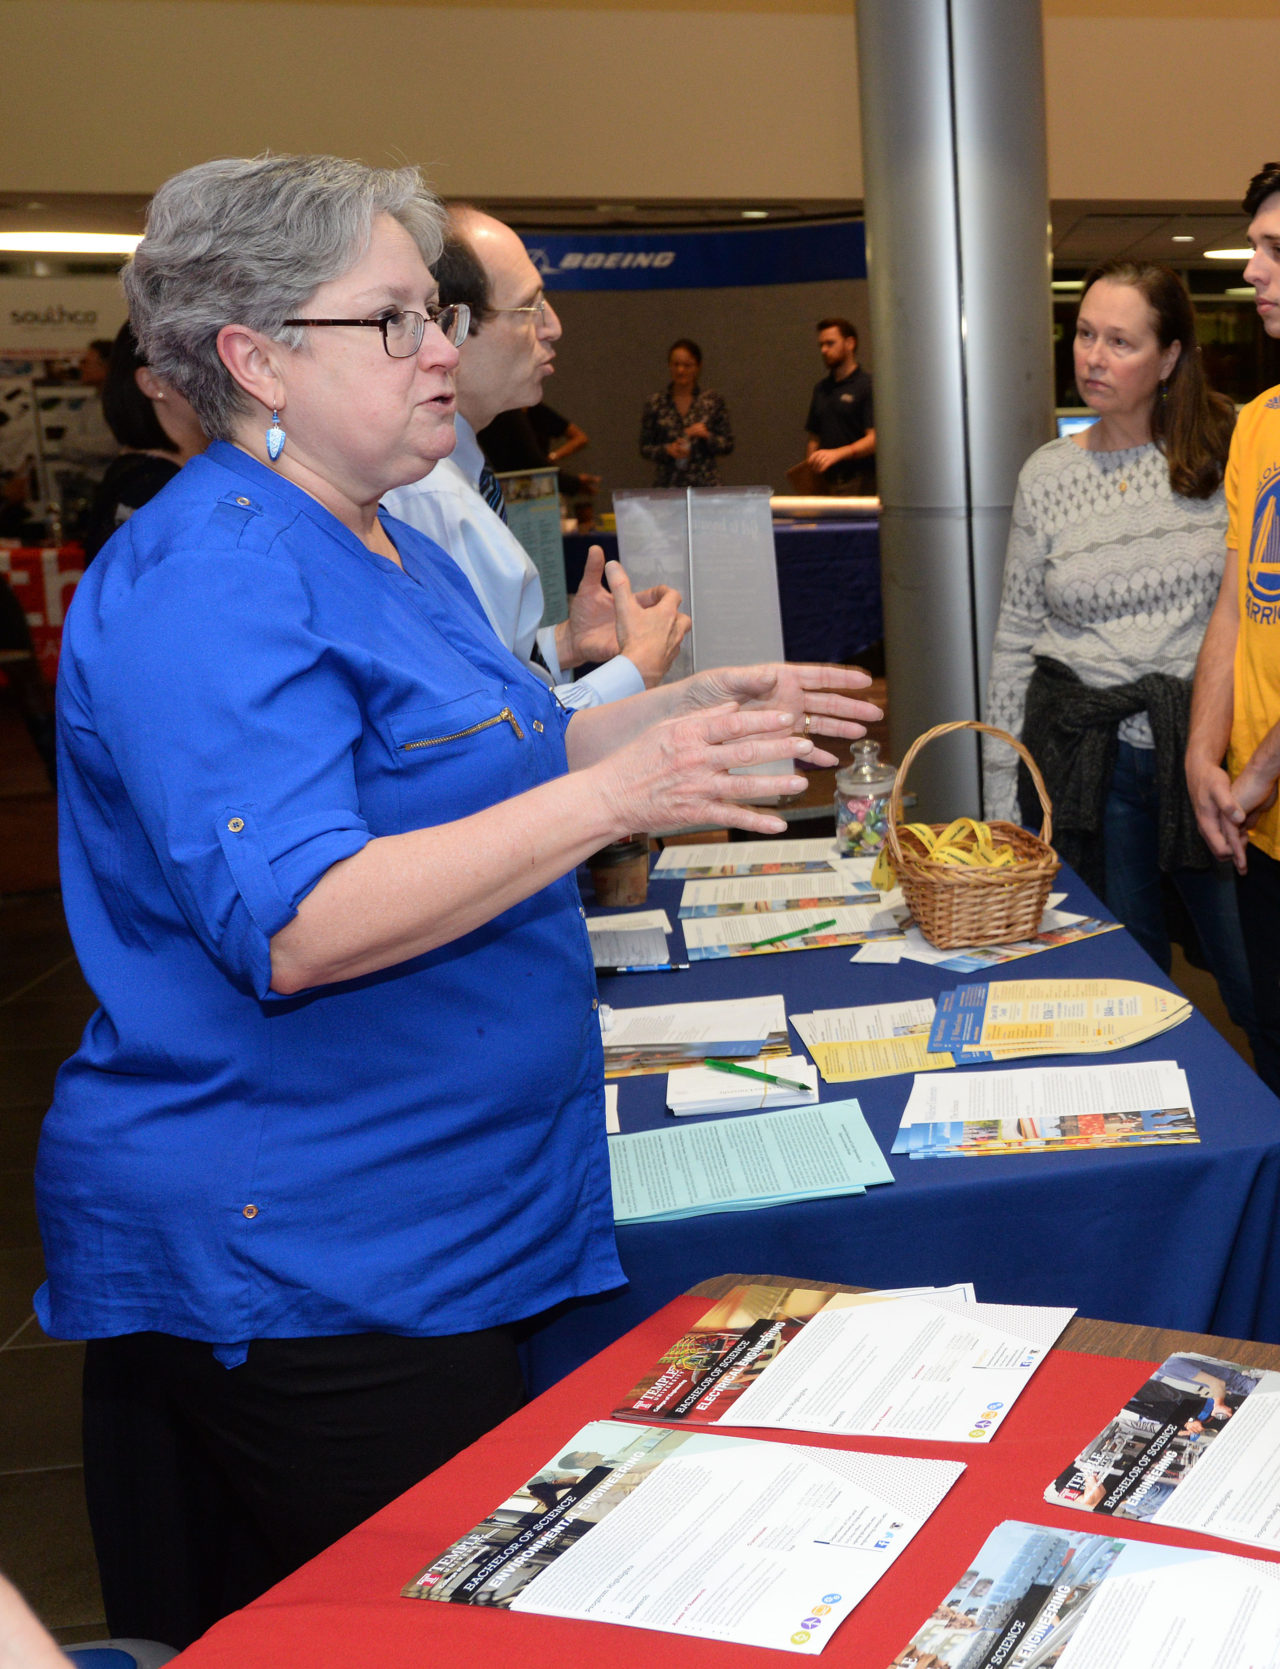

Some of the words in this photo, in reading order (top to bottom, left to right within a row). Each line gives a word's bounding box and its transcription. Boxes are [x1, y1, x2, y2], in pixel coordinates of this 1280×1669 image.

[559, 252, 676, 269] BOEING
[640, 1365, 679, 1400] TEMPLE
[674, 1376, 715, 1413] BACHELOR
[711, 1366, 724, 1378] OF
[719, 1340, 750, 1368] SCIENCE
[696, 1368, 744, 1411] ELECTRICAL
[739, 1321, 786, 1367] ENGINEERING
[1065, 1451, 1104, 1490] TEMLE
[1103, 1466, 1141, 1509] BACHELOR
[1138, 1454, 1151, 1467] OF
[1147, 1423, 1178, 1457] SCIENCE
[1126, 1450, 1178, 1507] ENGINEERING
[463, 1546, 523, 1592] BACHELOR
[518, 1530, 535, 1545] OF
[532, 1495, 577, 1532] SCIENCE
[488, 1511, 582, 1588] ENVIRONMENTAL
[580, 1450, 646, 1511] ENGINEERING
[429, 1533, 484, 1572] TEMPLE
[991, 1619, 1027, 1666] SCIENCE
[1019, 1584, 1073, 1667] ENGINEERING
